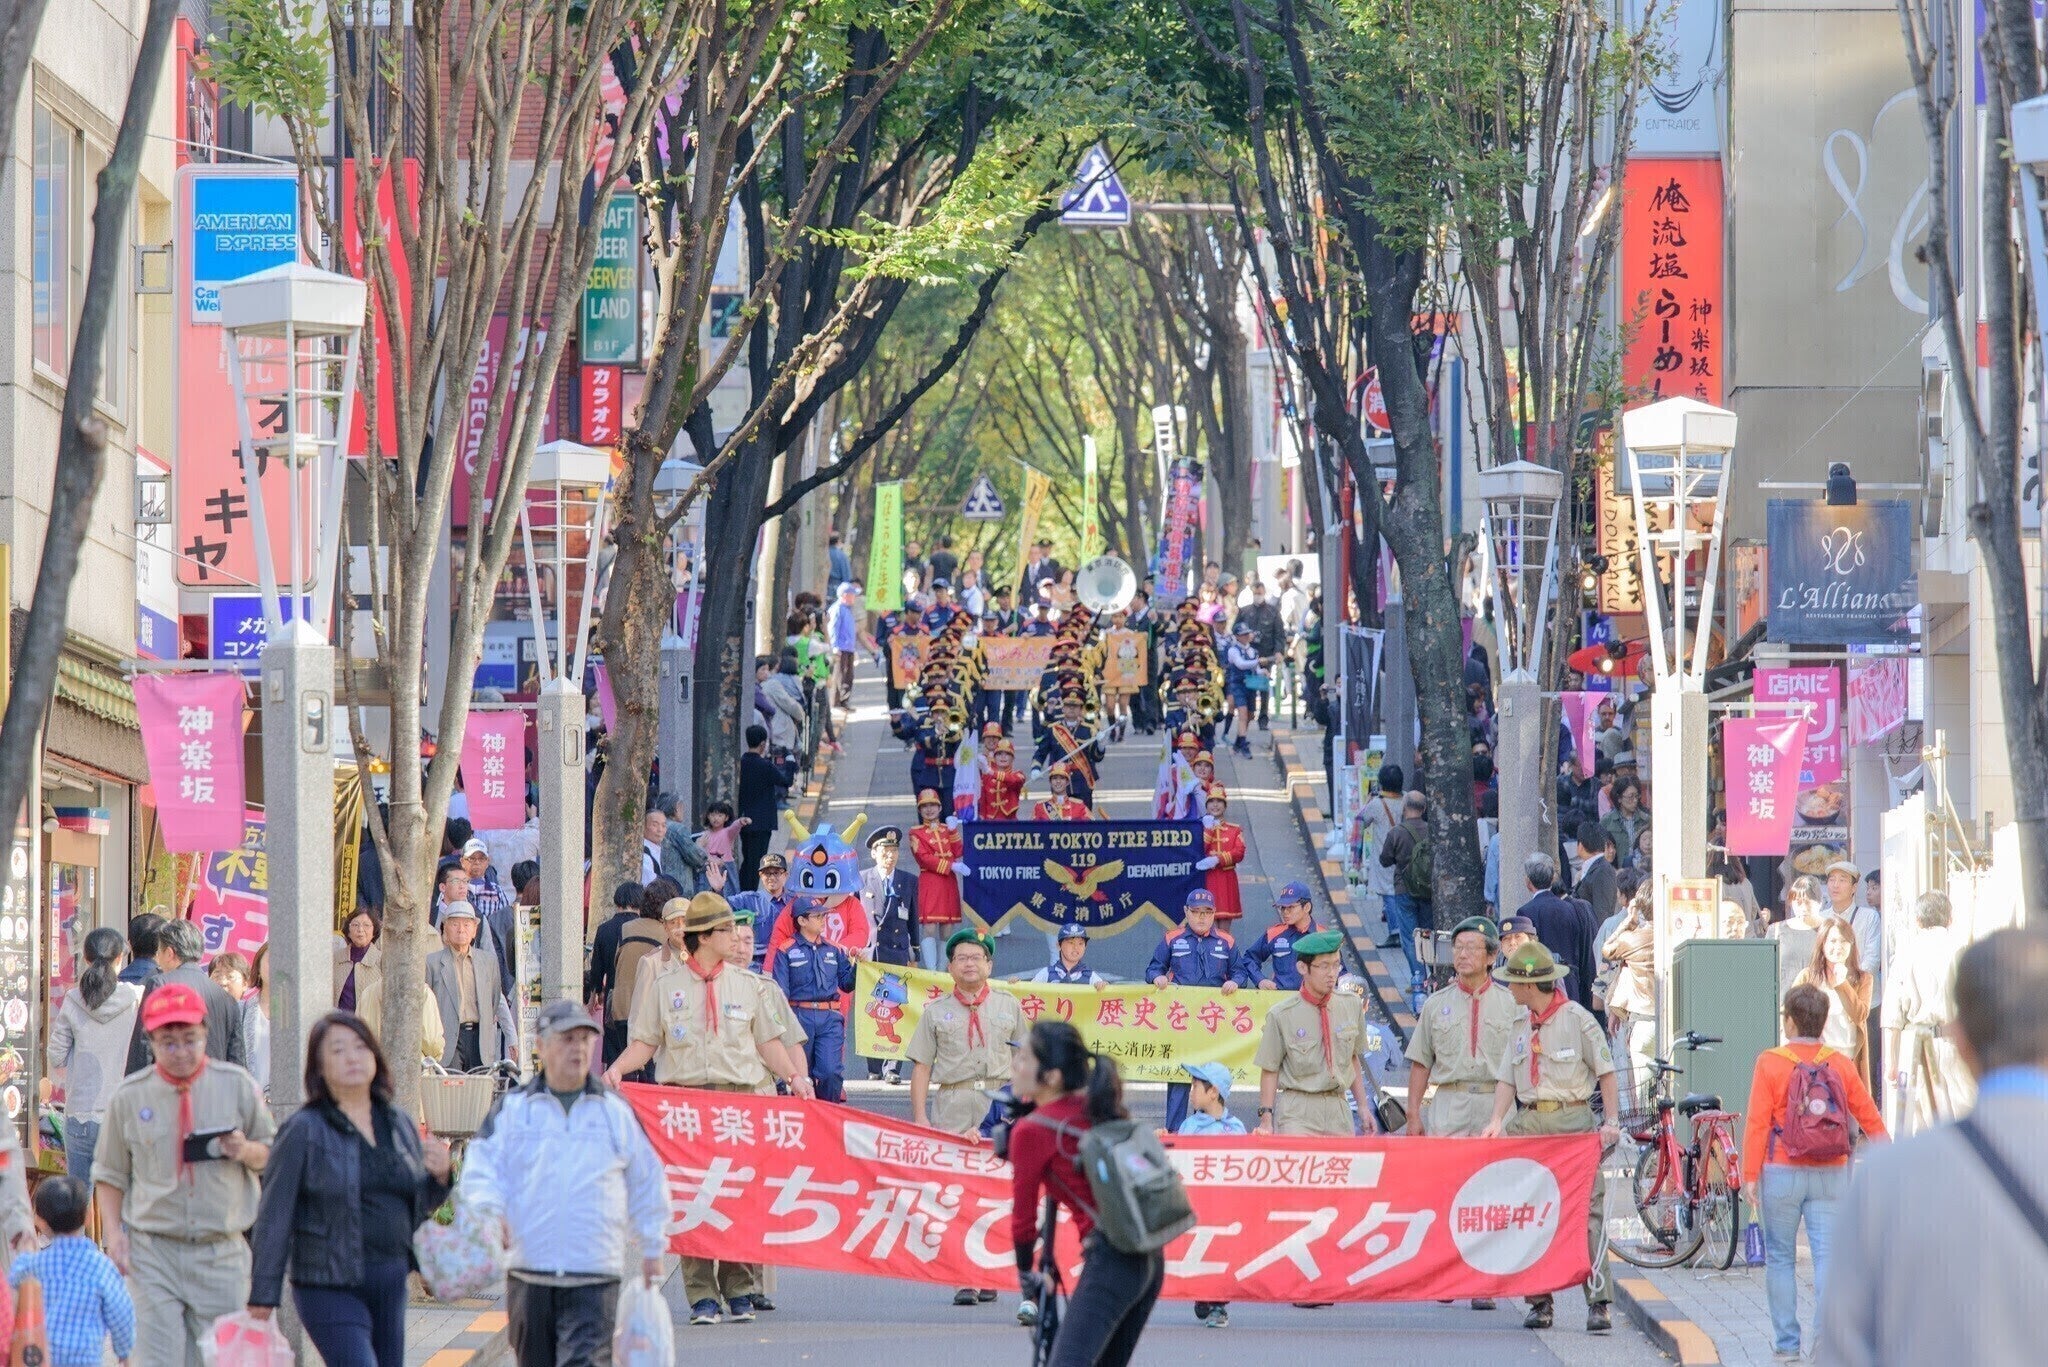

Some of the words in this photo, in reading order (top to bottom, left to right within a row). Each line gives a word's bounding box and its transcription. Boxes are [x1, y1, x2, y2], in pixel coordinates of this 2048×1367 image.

[1645, 118, 1701, 131] ENTRAIDE
[194, 214, 292, 232] AMERICAN
[215, 234, 298, 251] EXPRESS
[586, 266, 636, 291] SERVER
[590, 297, 631, 320] LAND
[590, 367, 612, 444] カラオケ
[223, 641, 269, 657] コンタ
[1768, 673, 1830, 696] 店内に
[178, 705, 216, 804] 神楽坂
[481, 732, 507, 799] 神楽坂
[1746, 743, 1776, 821] 神楽坂
[973, 833, 1044, 850] CAPITAL
[1049, 831, 1103, 850] TOKYO
[1107, 830, 1148, 848] FIRE
[1151, 829, 1193, 847] BIRD
[978, 866, 1013, 880] TOKYO
[1015, 866, 1041, 879] FIRE
[1127, 861, 1192, 879] DEPARTMENT
[1070, 852, 1097, 867] 119
[1029, 890, 1134, 922] 東京消防庁
[1096, 996, 1254, 1034] 歴史を守る
[1090, 1038, 1174, 1060] 牛込消防署
[657, 1100, 807, 1152] 神楽坂
[1192, 1153, 1354, 1186] まちの文化祭
[1456, 1202, 1554, 1235] 開催中!
